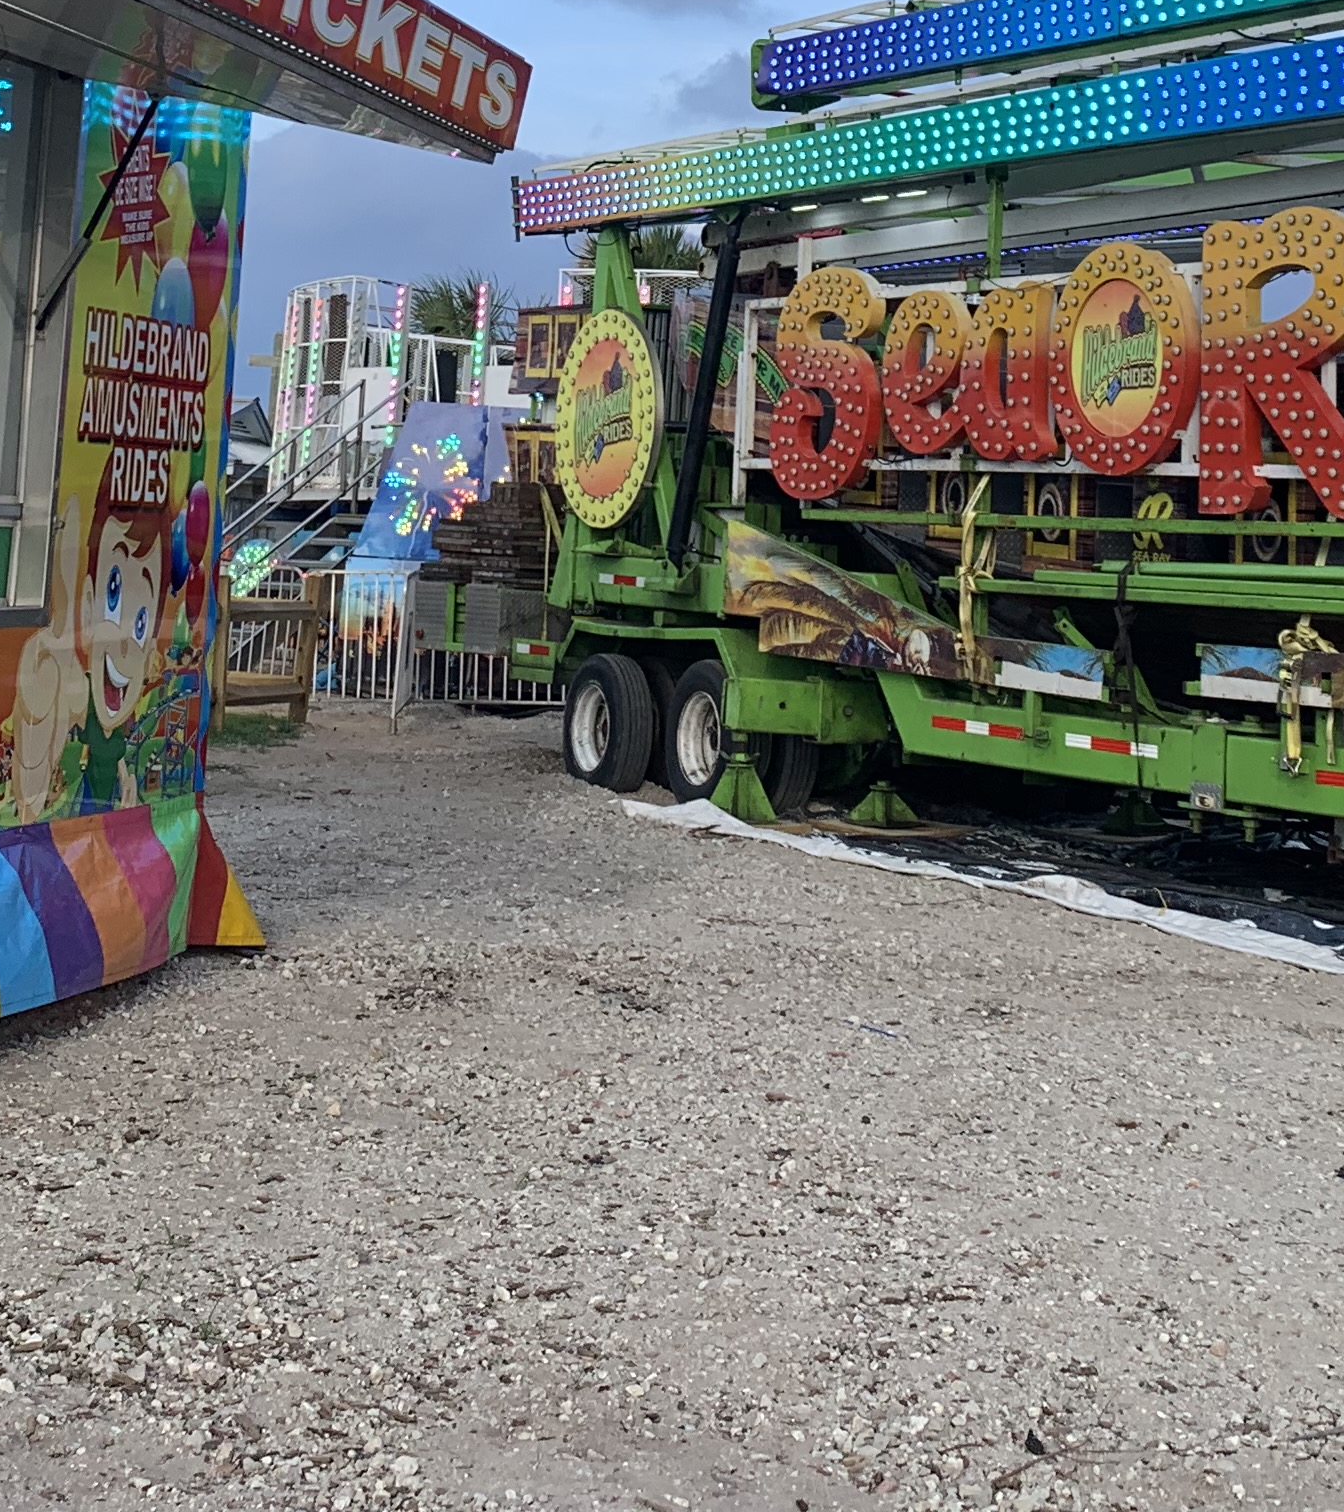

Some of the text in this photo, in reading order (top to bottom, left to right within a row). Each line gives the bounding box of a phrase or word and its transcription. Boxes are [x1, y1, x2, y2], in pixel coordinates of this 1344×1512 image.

[125, 222, 136, 232] THE
[84, 309, 210, 384] HILDEBRAND
[1120, 365, 1156, 388] RIDES
[79, 376, 204, 445] AMUSMENTS
[602, 417, 633, 445] RIDES
[109, 445, 170, 505] RIDES
